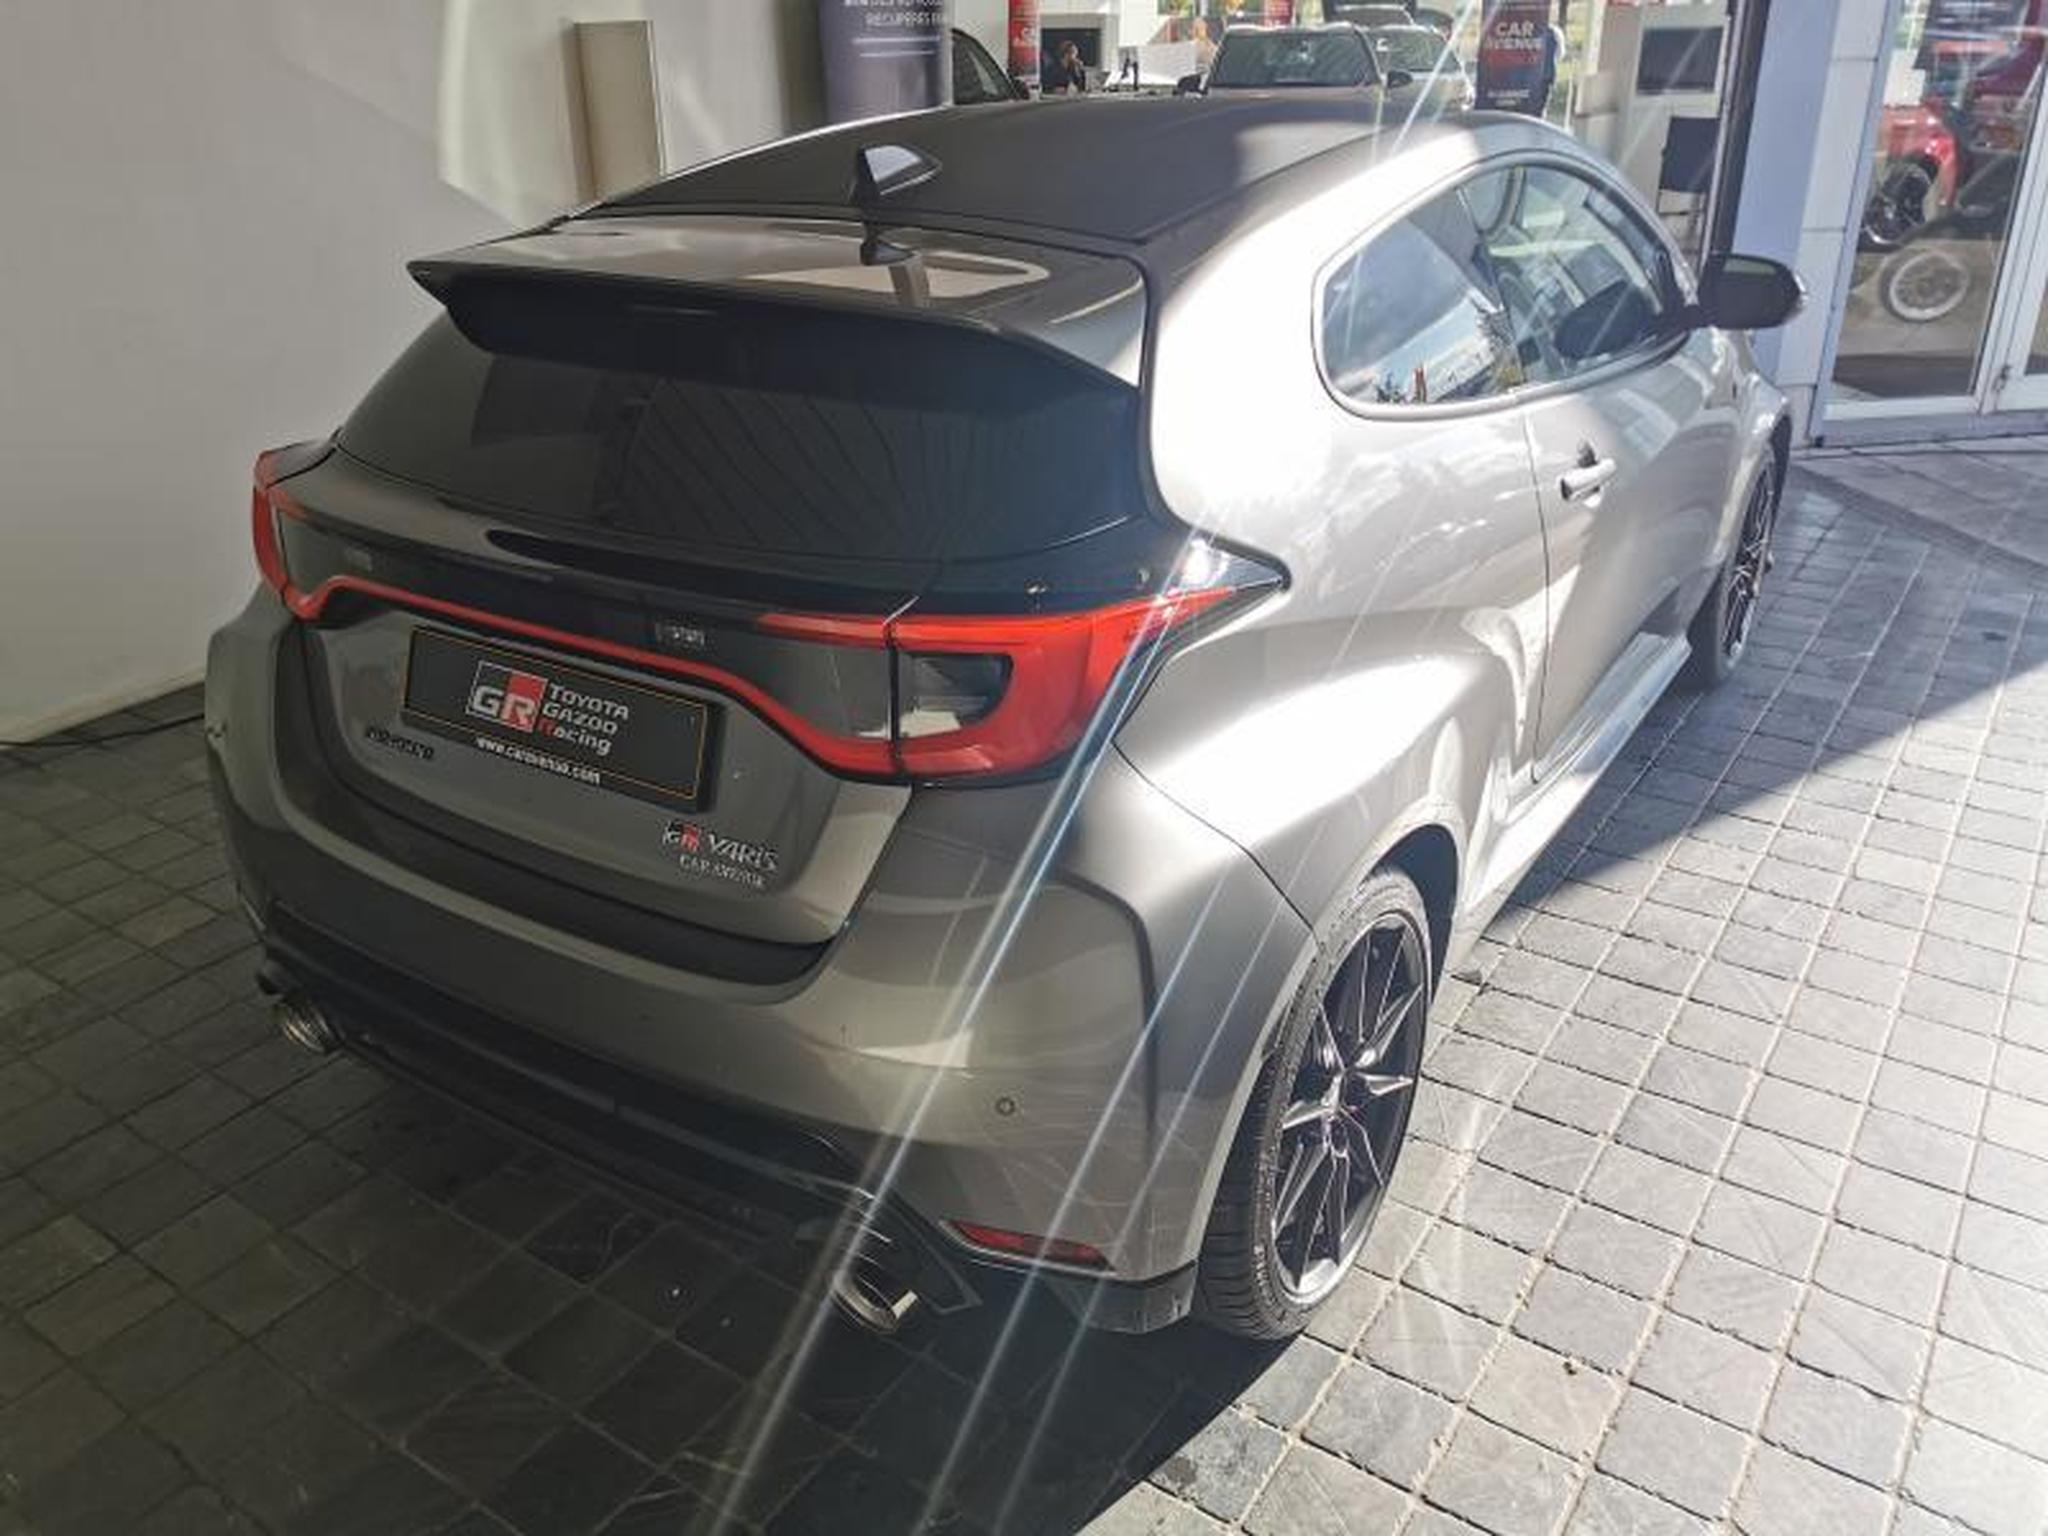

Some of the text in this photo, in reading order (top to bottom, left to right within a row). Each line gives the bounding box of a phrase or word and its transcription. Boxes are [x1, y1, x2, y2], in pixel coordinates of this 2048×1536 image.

[1496, 21, 1535, 38] CAR
[471, 685, 540, 732] GR
[542, 702, 619, 736] GAZOO
[549, 682, 630, 721] TOYOTA
[538, 717, 613, 757] Racing
